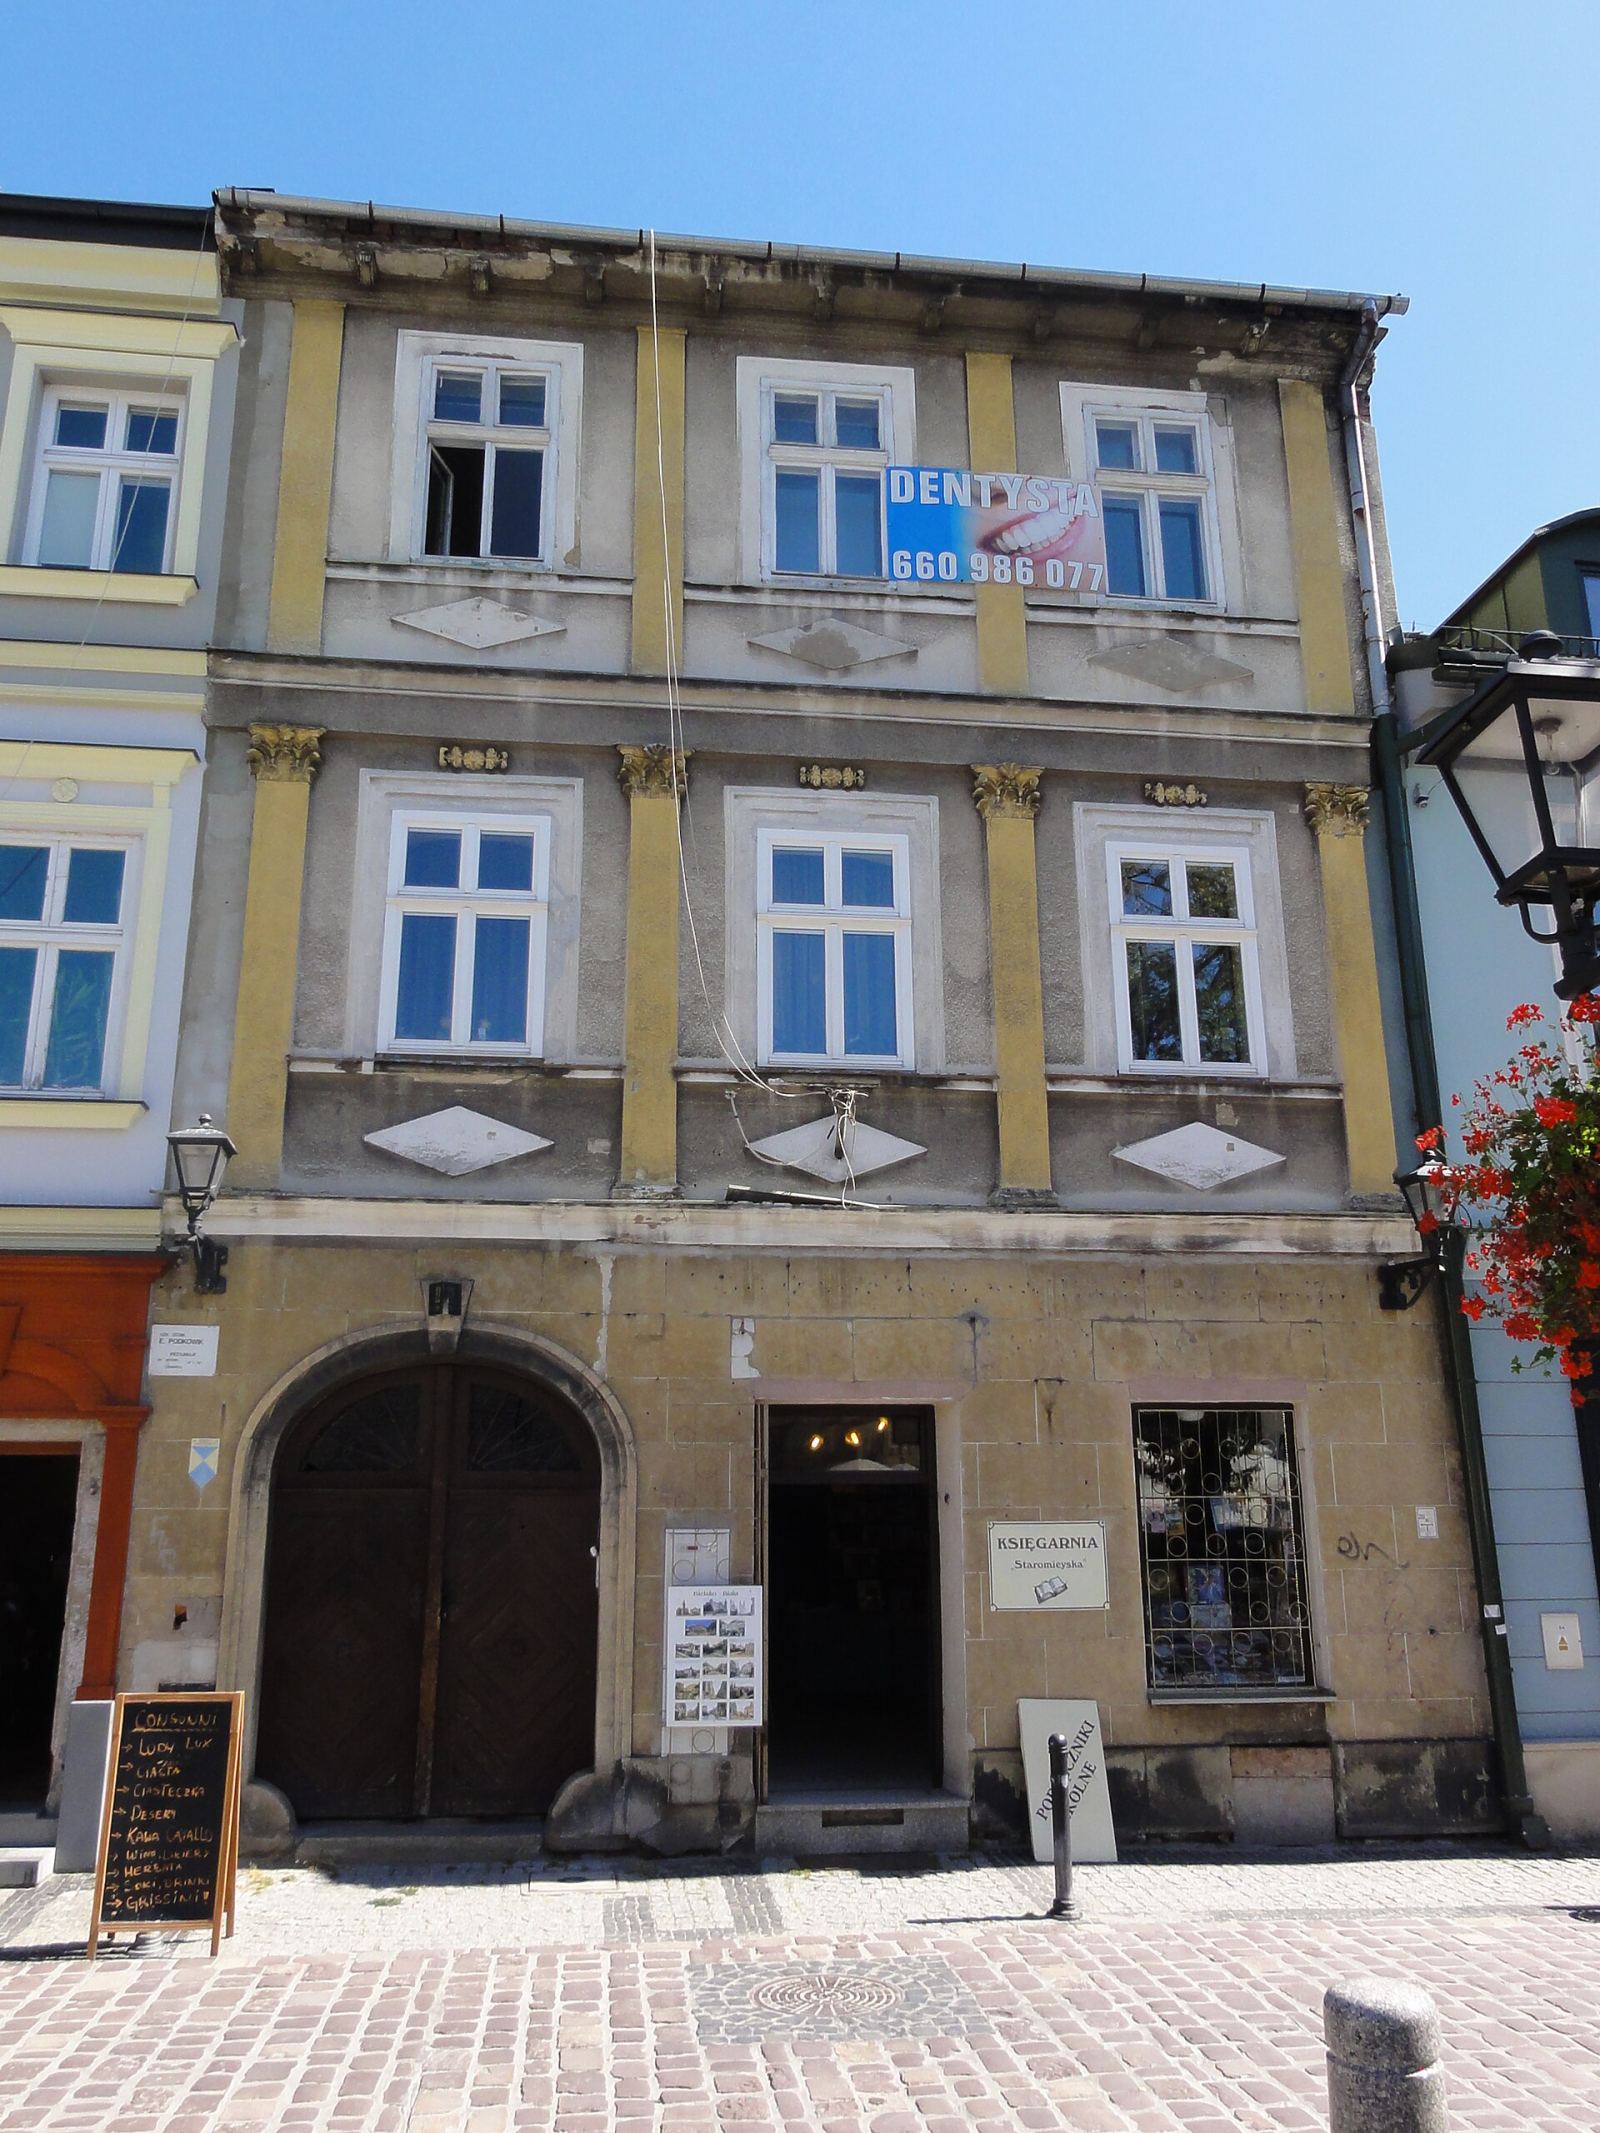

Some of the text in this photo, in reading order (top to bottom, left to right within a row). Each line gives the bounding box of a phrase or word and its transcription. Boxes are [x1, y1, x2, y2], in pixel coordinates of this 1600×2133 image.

[890, 469, 1099, 518] DENTYSTA
[892, 550, 1104, 592] 660 986 077
[997, 1536, 1098, 1551] KSIĘGARNIA
[133, 1783, 205, 1798] CIASTECZKA
[130, 1804, 176, 1822] DESERY
[126, 1826, 160, 1845] KAWA
